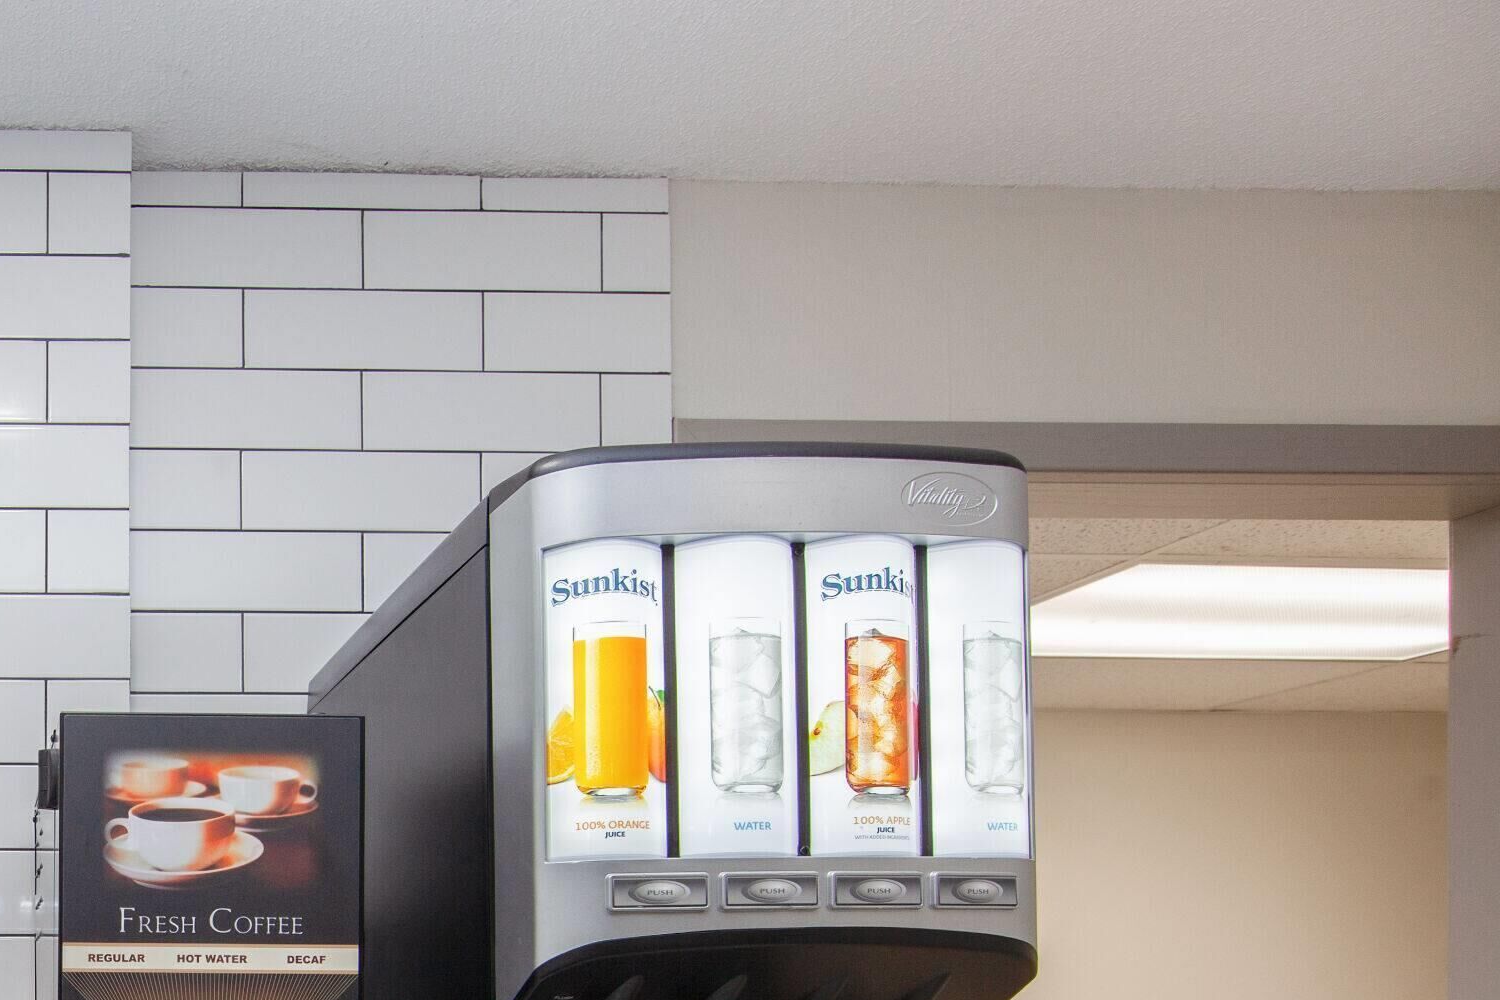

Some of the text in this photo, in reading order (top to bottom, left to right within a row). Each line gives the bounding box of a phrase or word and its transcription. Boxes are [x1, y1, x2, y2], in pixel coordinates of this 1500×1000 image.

[907, 478, 964, 518] Vitality
[551, 568, 658, 607] Sunkist
[576, 820, 650, 831] 100% ORANGE
[853, 815, 911, 826] 100% APPLE
[734, 821, 772, 831] WATER
[877, 826, 895, 834] JUICE
[987, 822, 1018, 832] WATER
[605, 831, 626, 839] JUICE
[759, 887, 786, 895] PUSH
[118, 907, 304, 935] FRESH COFFEE
[88, 953, 146, 963] REGULAR
[177, 954, 248, 965] HOT WATER
[287, 955, 327, 965] DECAF
